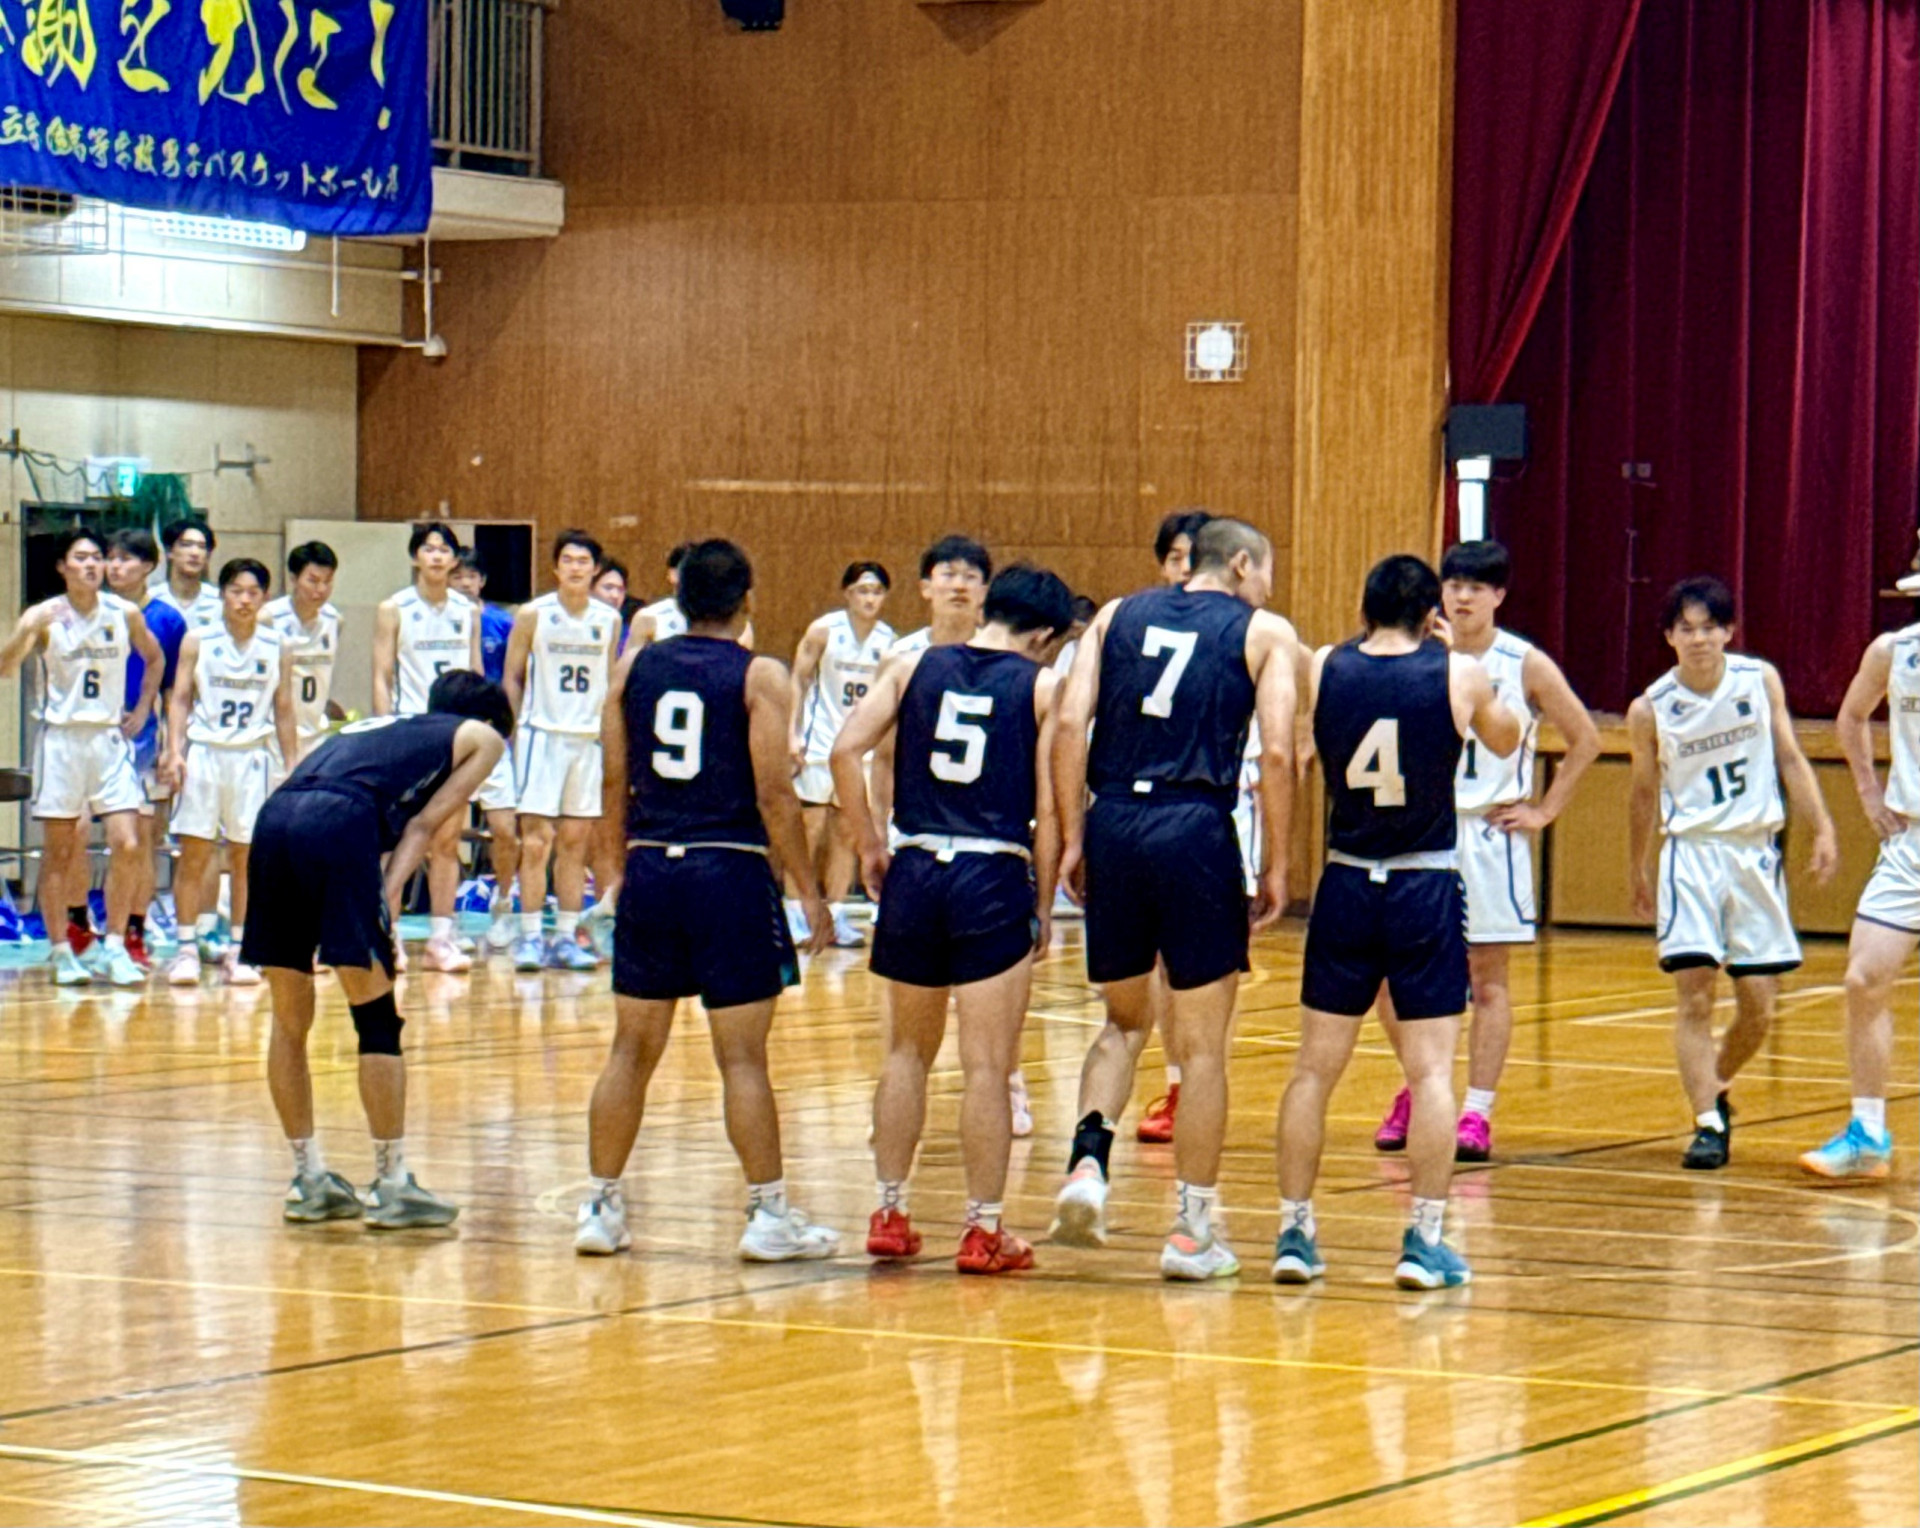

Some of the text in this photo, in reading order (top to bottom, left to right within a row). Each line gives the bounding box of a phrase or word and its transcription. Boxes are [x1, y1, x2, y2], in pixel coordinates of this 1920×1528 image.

[83, 669, 100, 699] 6
[302, 675, 316, 702] 0
[560, 664, 590, 693] 26
[1141, 626, 1198, 718] 7
[220, 699, 254, 729] 22
[653, 690, 705, 780] 9
[929, 690, 993, 784] 5
[1346, 719, 1406, 807] 4
[1706, 757, 1749, 806] 15
